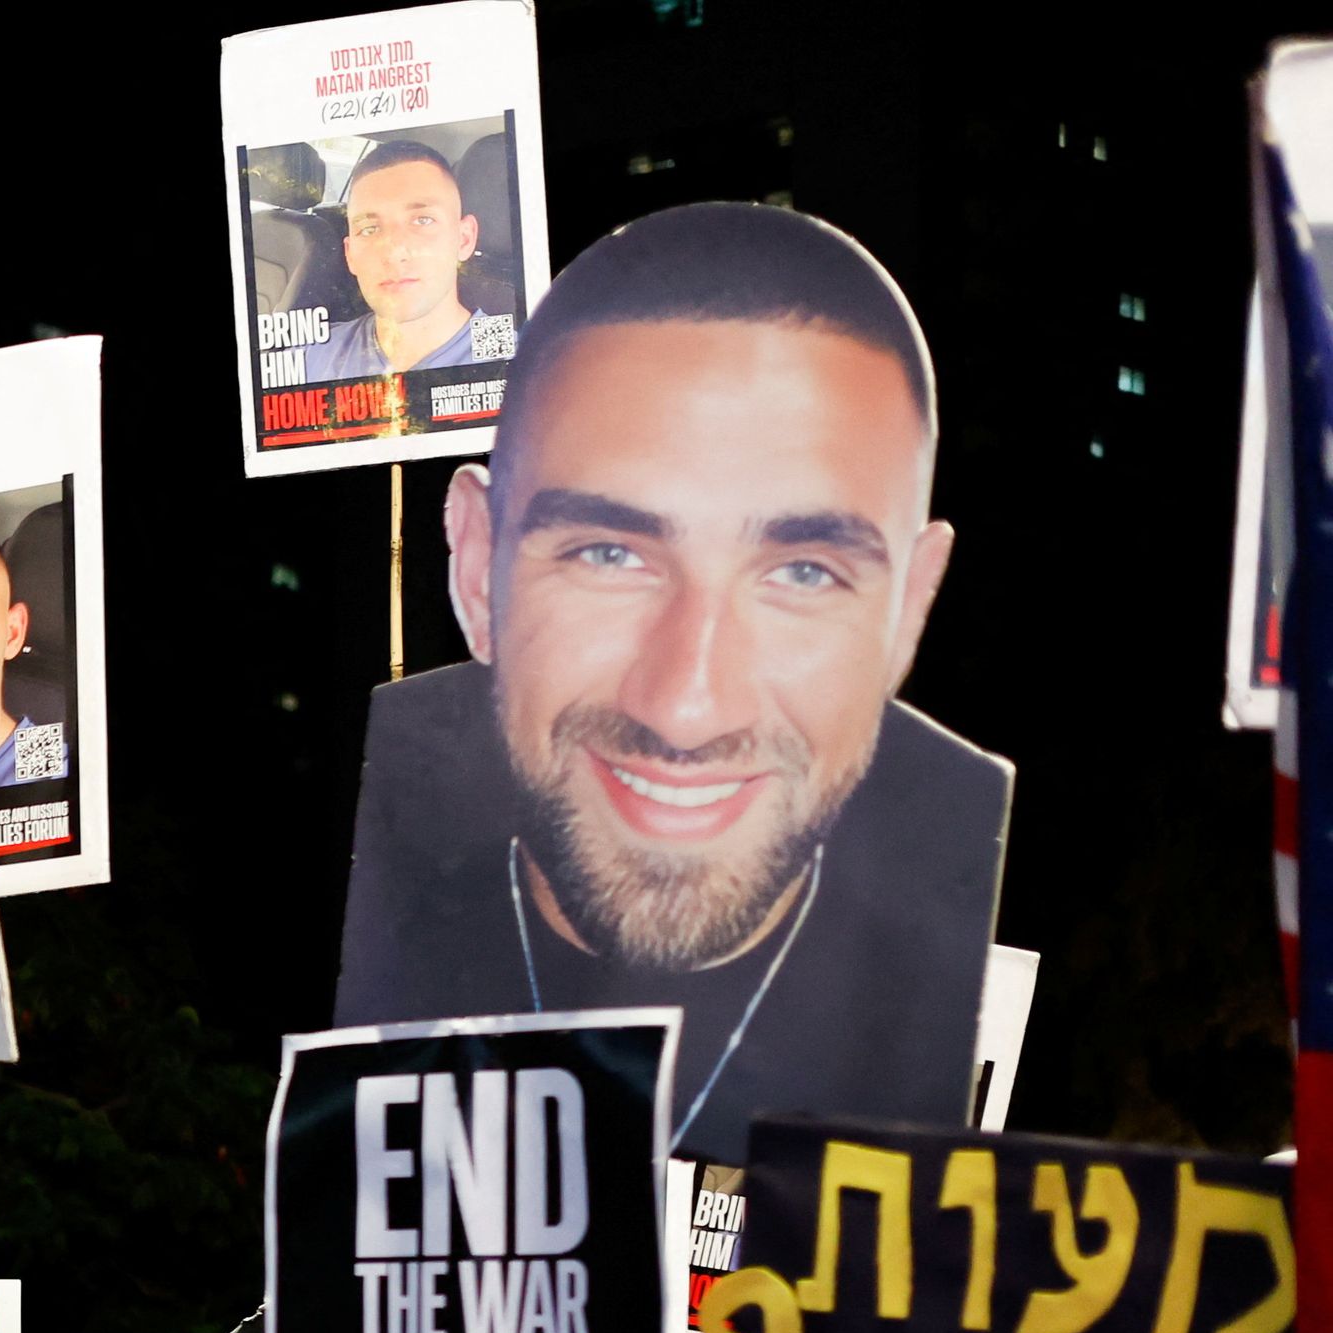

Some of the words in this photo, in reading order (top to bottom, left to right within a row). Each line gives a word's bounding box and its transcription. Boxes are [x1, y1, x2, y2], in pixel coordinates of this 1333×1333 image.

[387, 40, 413, 65] מתן
[316, 71, 363, 97] MATAN
[369, 62, 431, 90] ANGREST
[257, 307, 330, 350] BRING
[260, 346, 307, 389] HIM
[431, 383, 470, 399] HOSTAGES
[470, 380, 486, 395] AND
[432, 396, 482, 416] FAMILIES
[263, 388, 329, 431] HOME
[11, 806, 30, 823] AND
[30, 801, 69, 820] MISSING
[25, 815, 70, 844] FORUM
[355, 1067, 590, 1258] END
[689, 1229, 736, 1271] HIM
